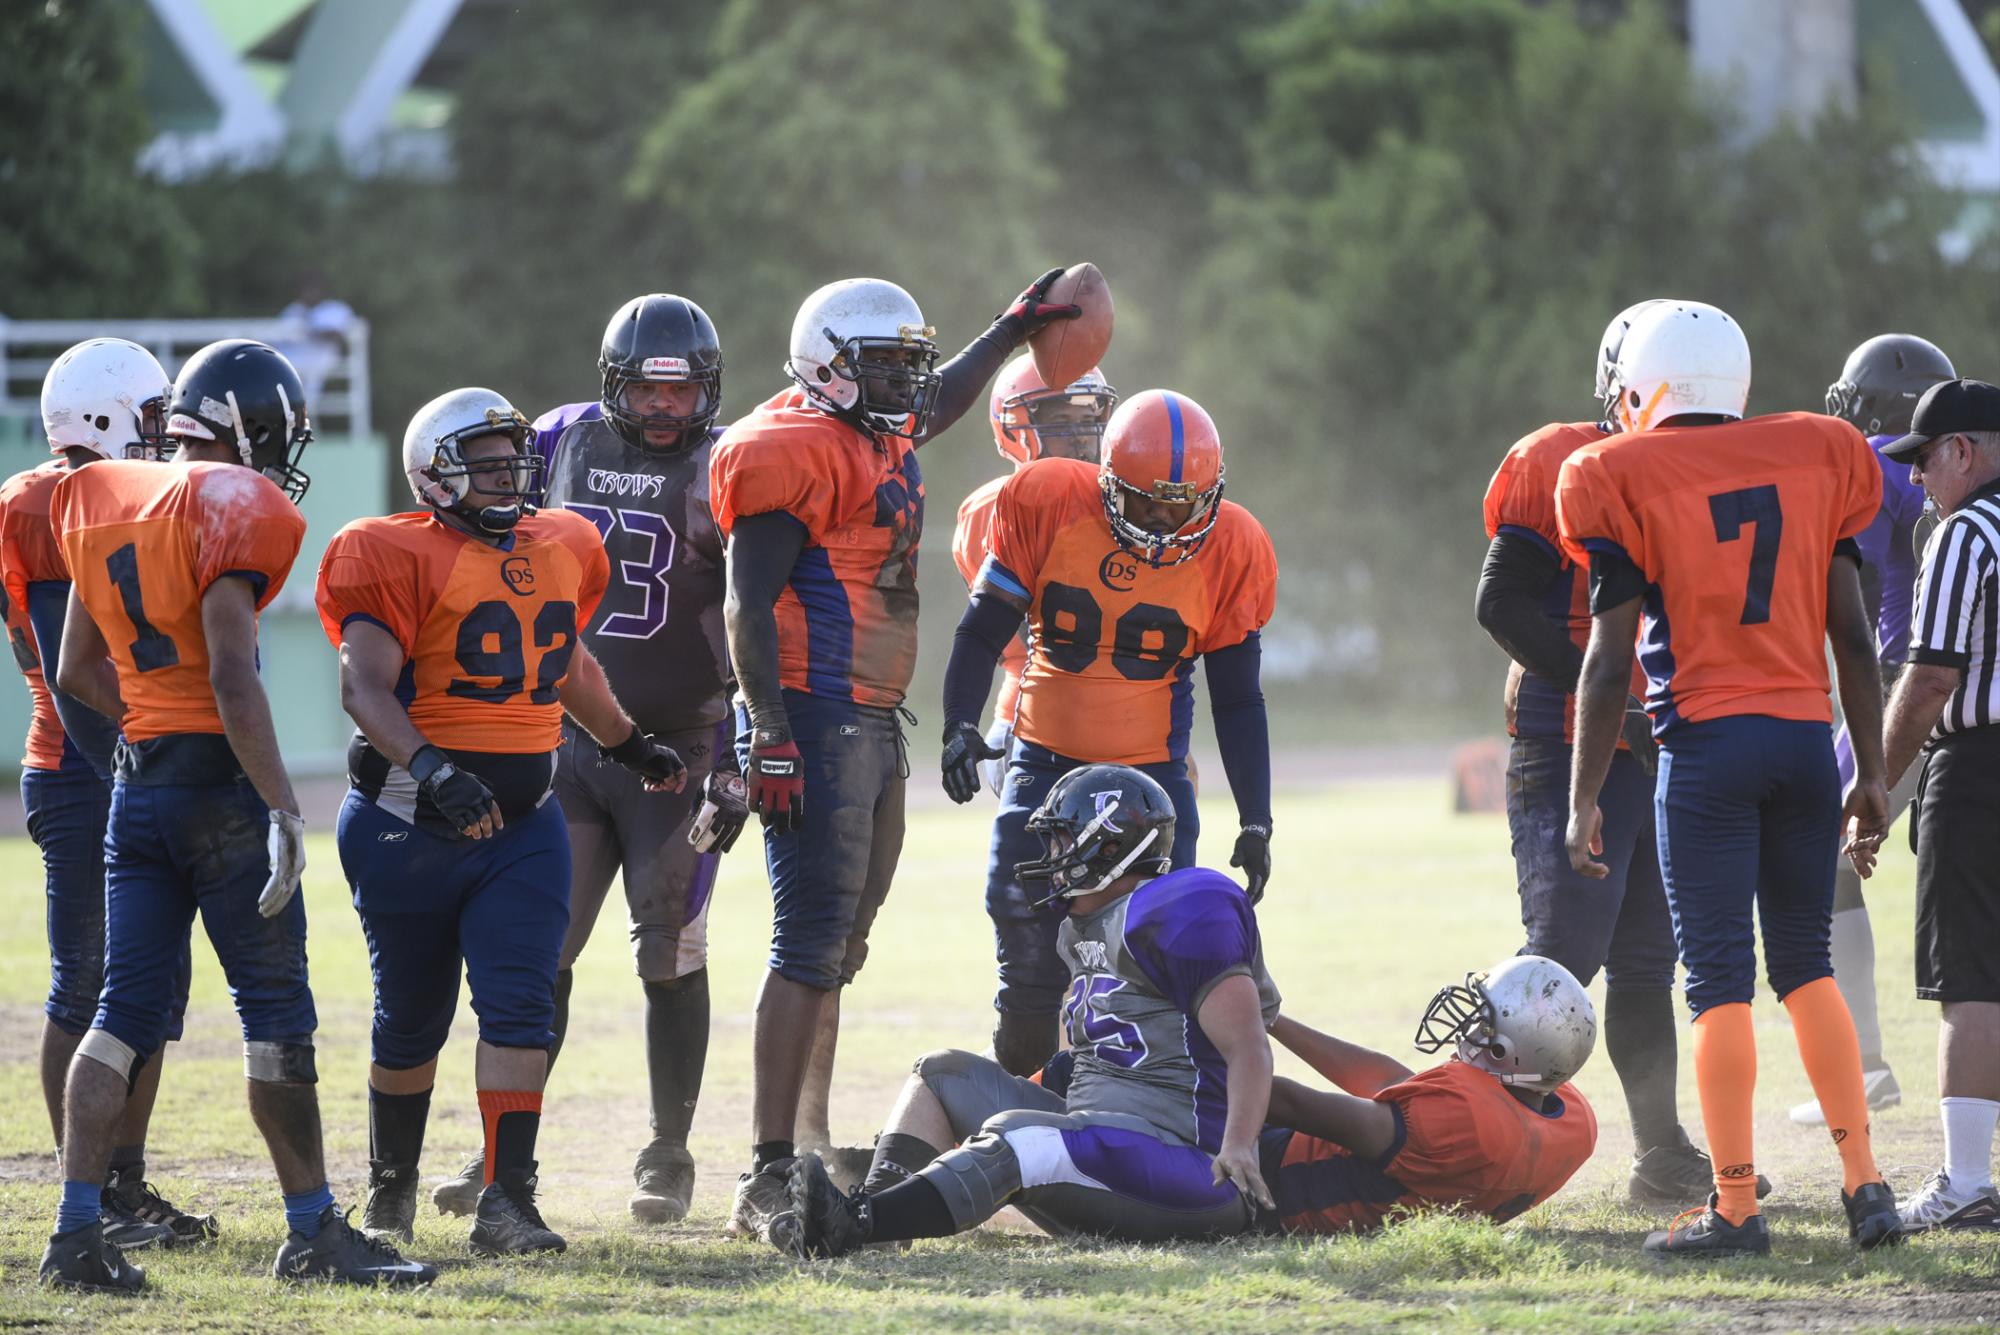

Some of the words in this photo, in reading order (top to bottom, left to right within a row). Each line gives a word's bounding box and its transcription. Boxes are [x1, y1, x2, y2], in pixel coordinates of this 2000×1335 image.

[653, 360, 679, 368] Riddell
[587, 467, 666, 499] CROWS
[1707, 483, 1783, 625] 7
[105, 542, 180, 673] 1
[445, 600, 578, 705] 92
